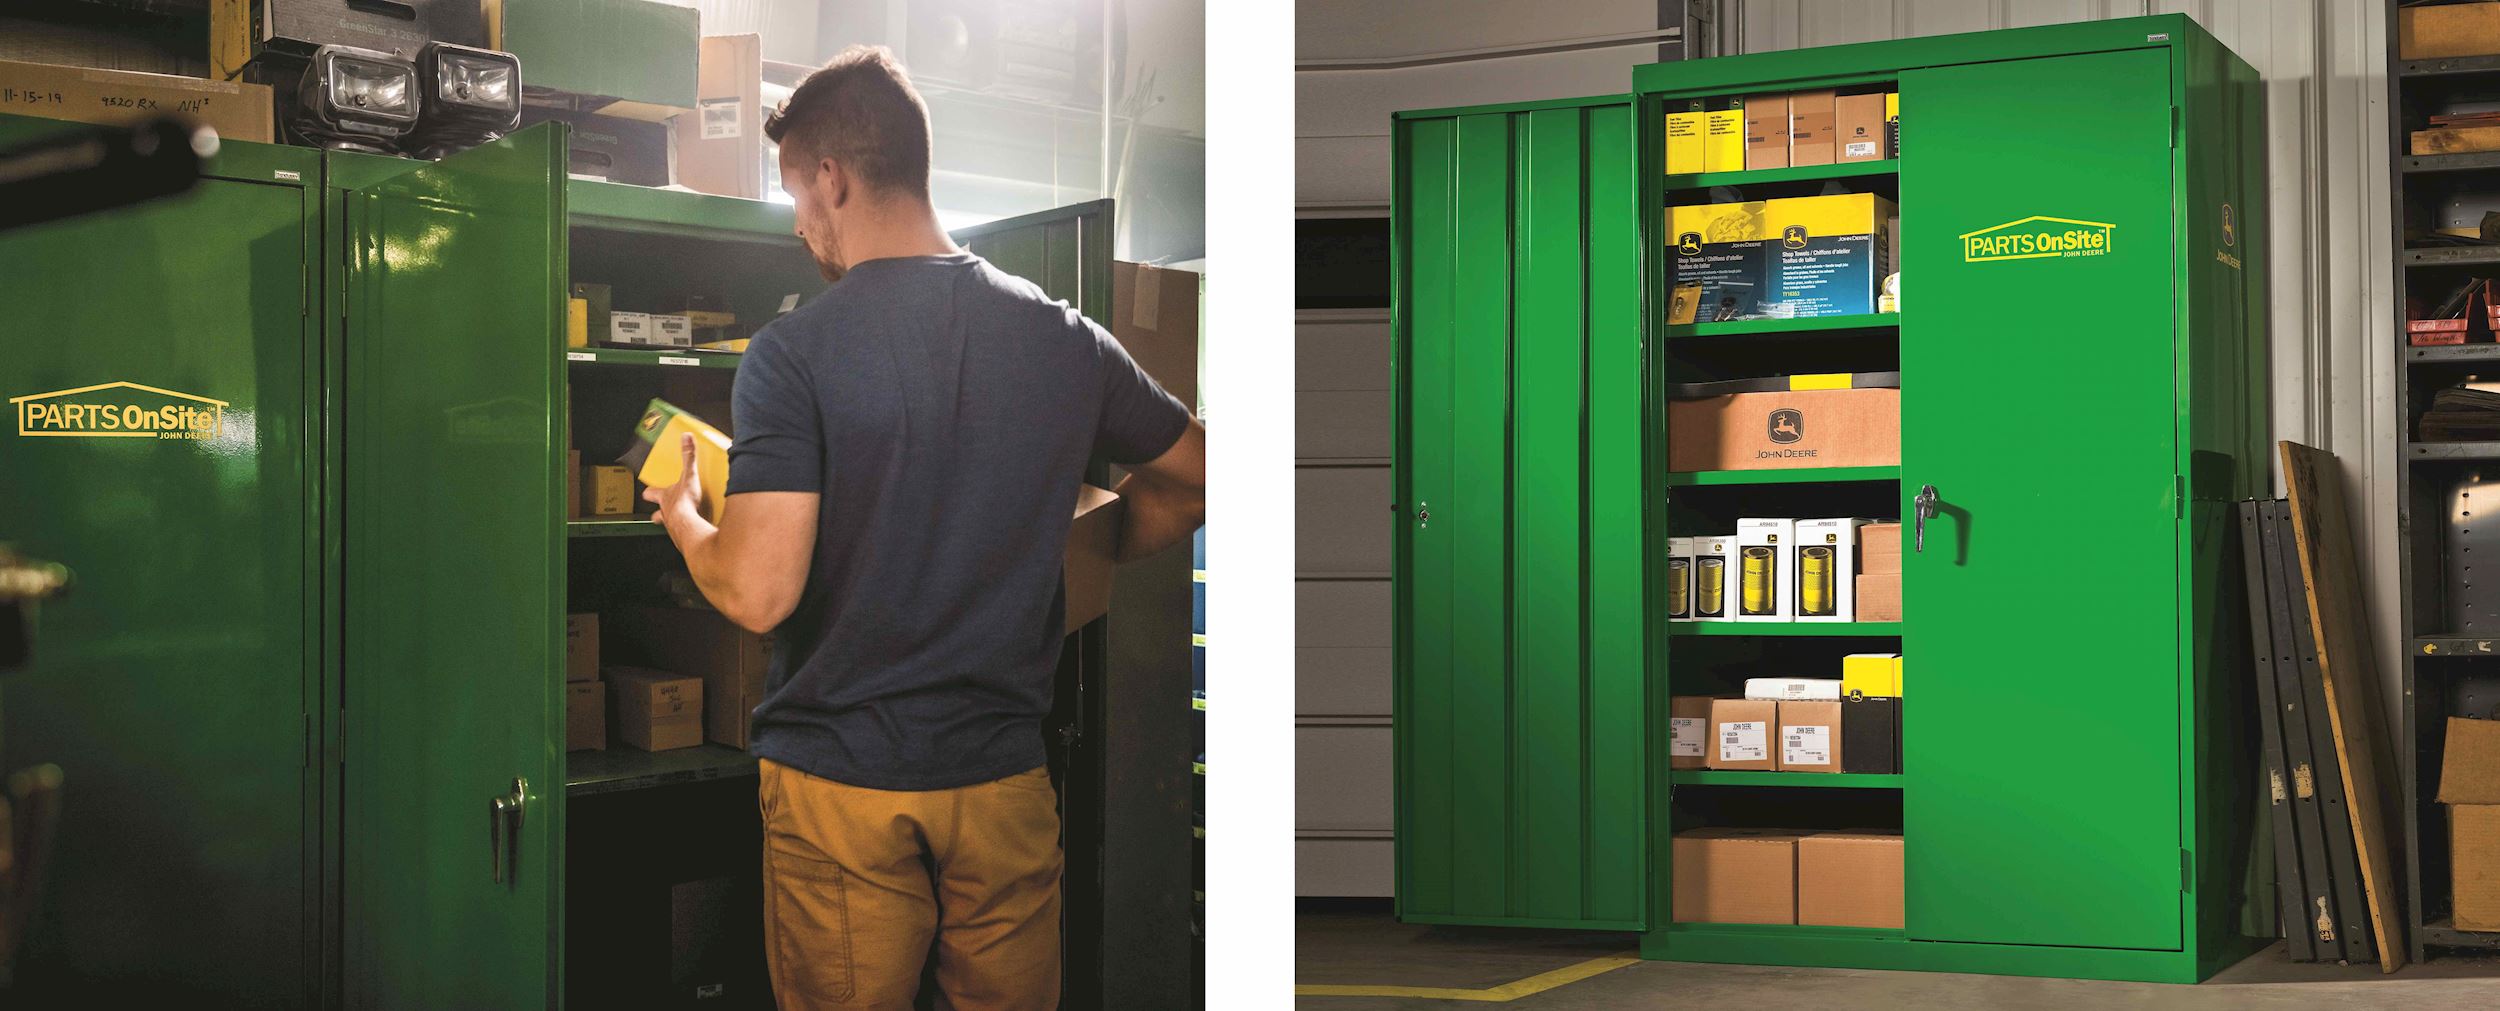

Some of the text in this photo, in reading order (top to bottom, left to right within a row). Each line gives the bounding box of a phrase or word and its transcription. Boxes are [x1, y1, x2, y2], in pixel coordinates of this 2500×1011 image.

[339, 19, 386, 36] GreenStar
[1970, 234, 2035, 256] PARTS
[2216, 249, 2241, 269] JOHN DEERE
[27, 403, 120, 429] PARTS
[160, 432, 183, 440] JOHN
[1755, 448, 1818, 459] JOHN DEERE
